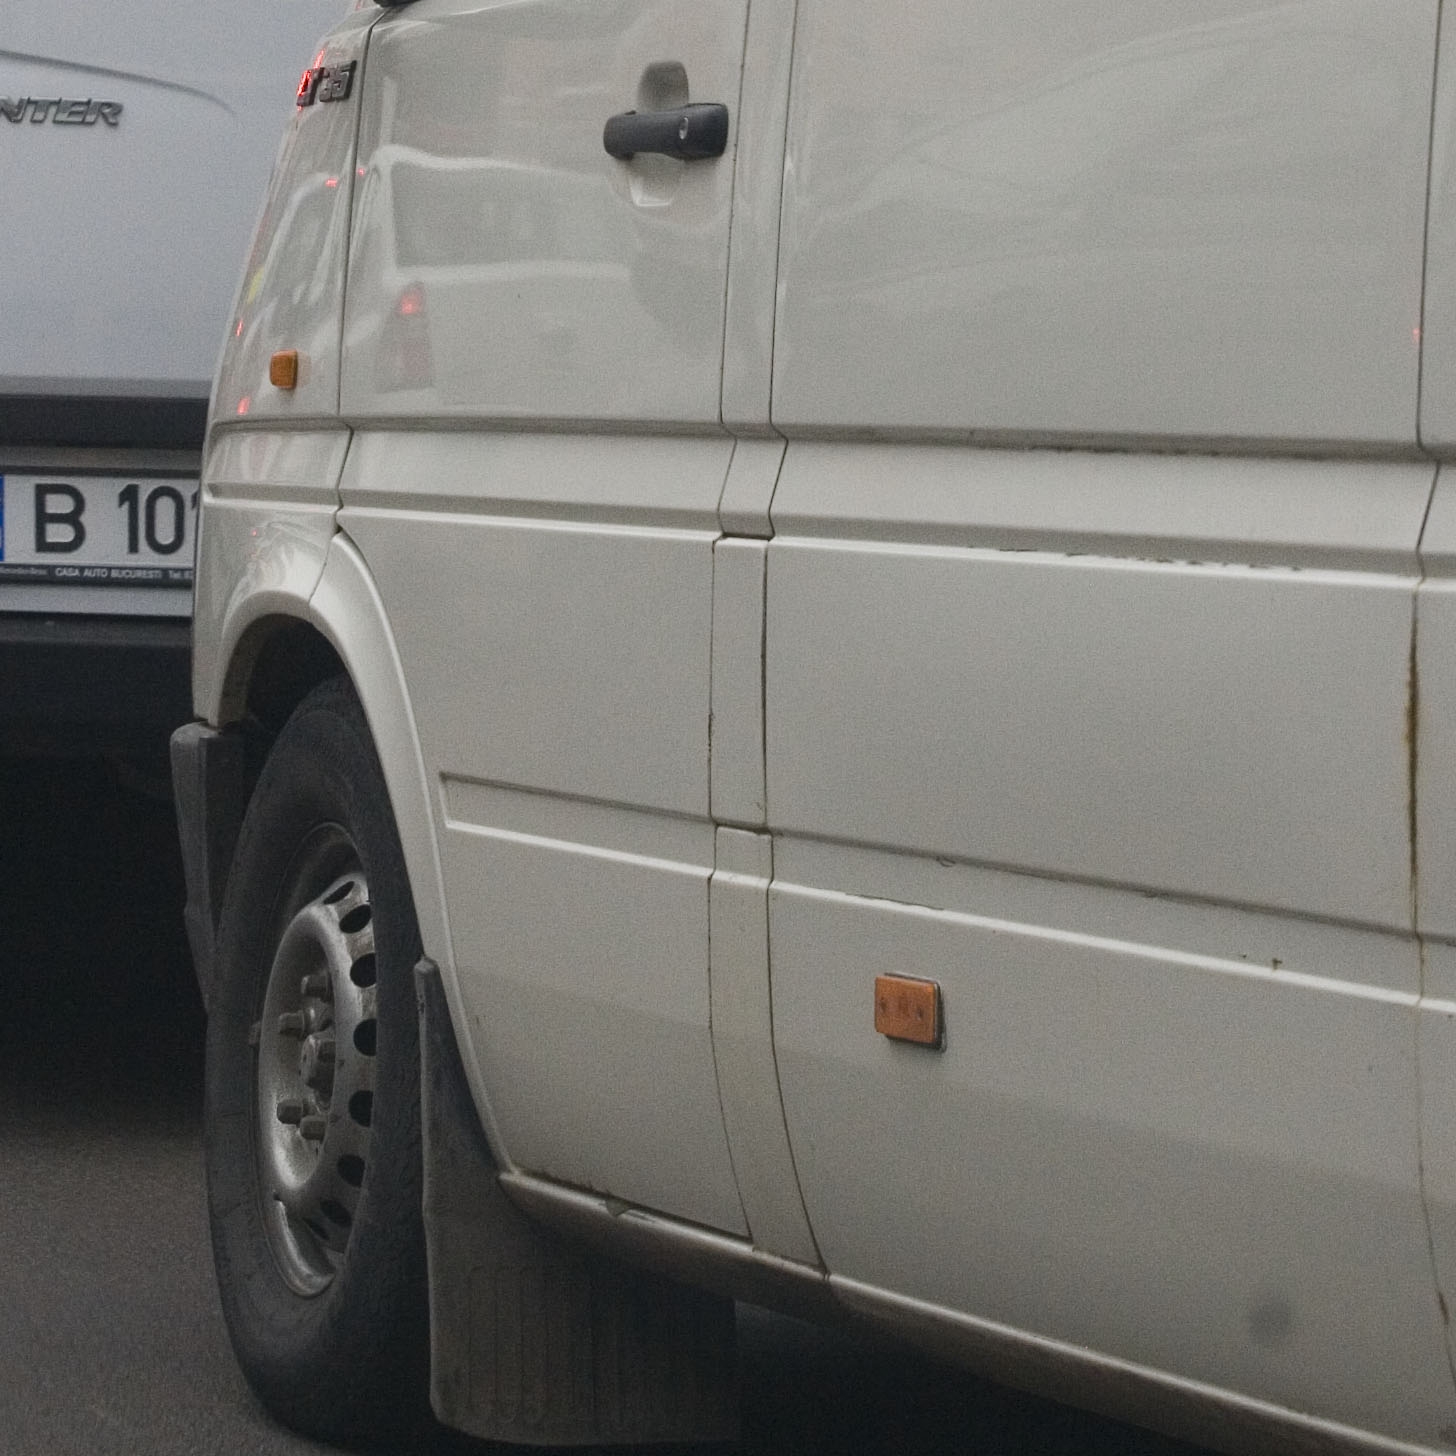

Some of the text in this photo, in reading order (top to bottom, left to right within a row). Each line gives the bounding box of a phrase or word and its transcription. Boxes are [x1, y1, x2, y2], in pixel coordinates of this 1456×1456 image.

[34, 483, 87, 554] B
[117, 483, 200, 556] 10
[54, 567, 80, 577] CASA
[83, 568, 109, 578] AUTO
